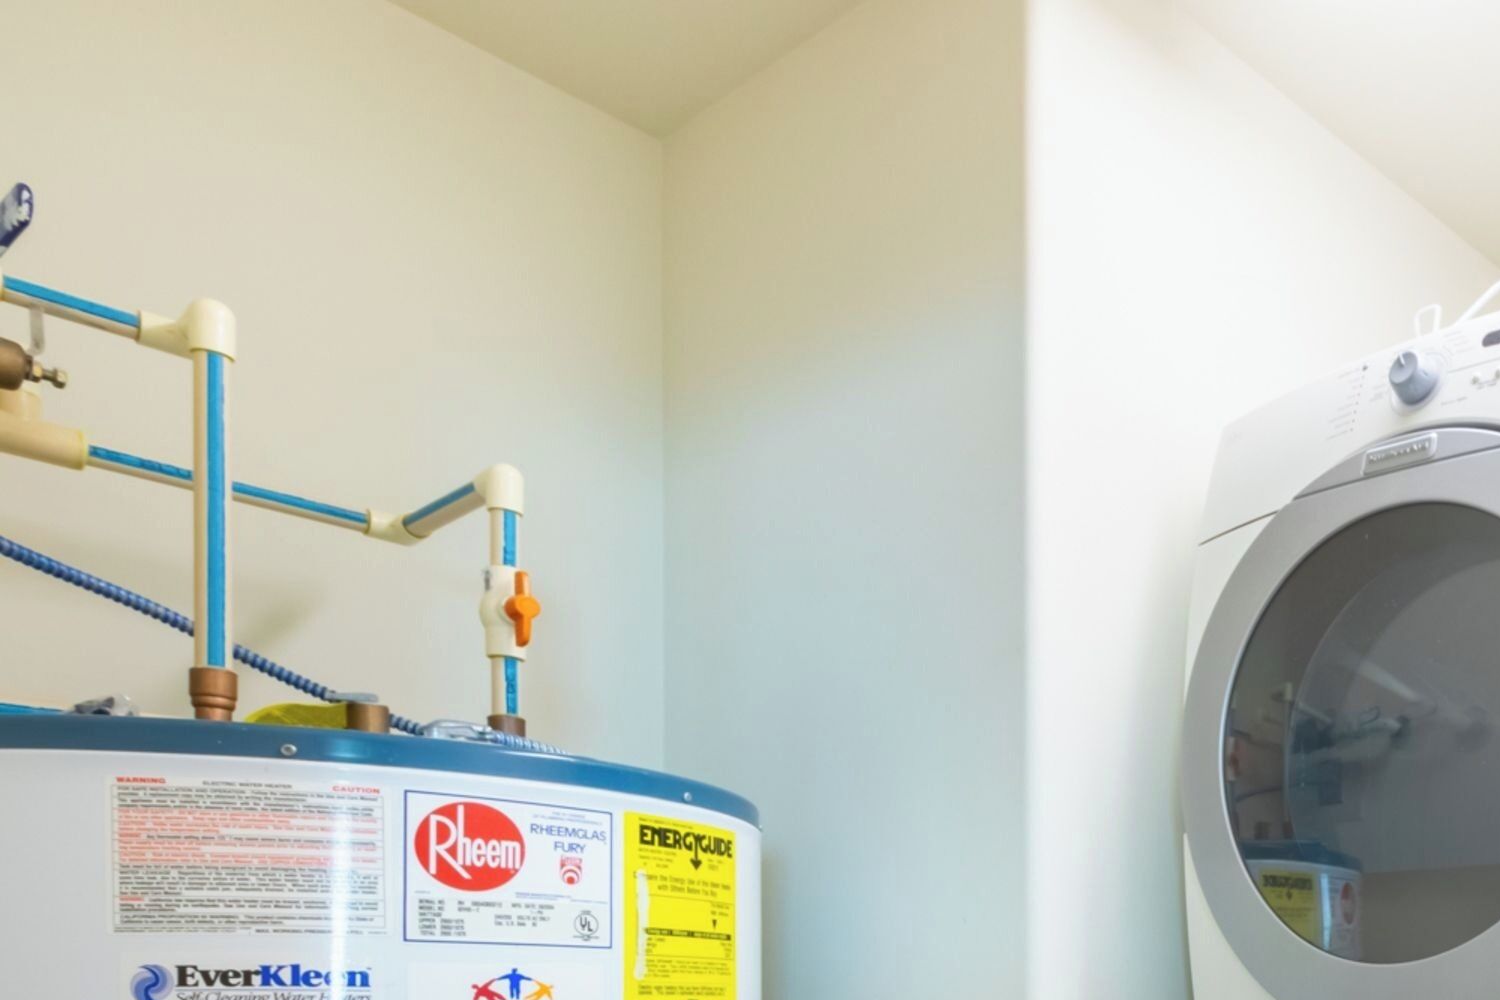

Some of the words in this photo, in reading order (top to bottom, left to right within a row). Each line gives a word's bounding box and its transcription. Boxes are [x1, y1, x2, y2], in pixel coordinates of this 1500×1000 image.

[115, 776, 166, 785] WARNING
[332, 784, 380, 795] CAUTION
[428, 803, 521, 880] Rheem
[530, 823, 608, 842] RHEEMGLAS
[639, 823, 734, 859] ENERGYGUIDE
[553, 841, 587, 854] FURY
[579, 913, 594, 932] UL
